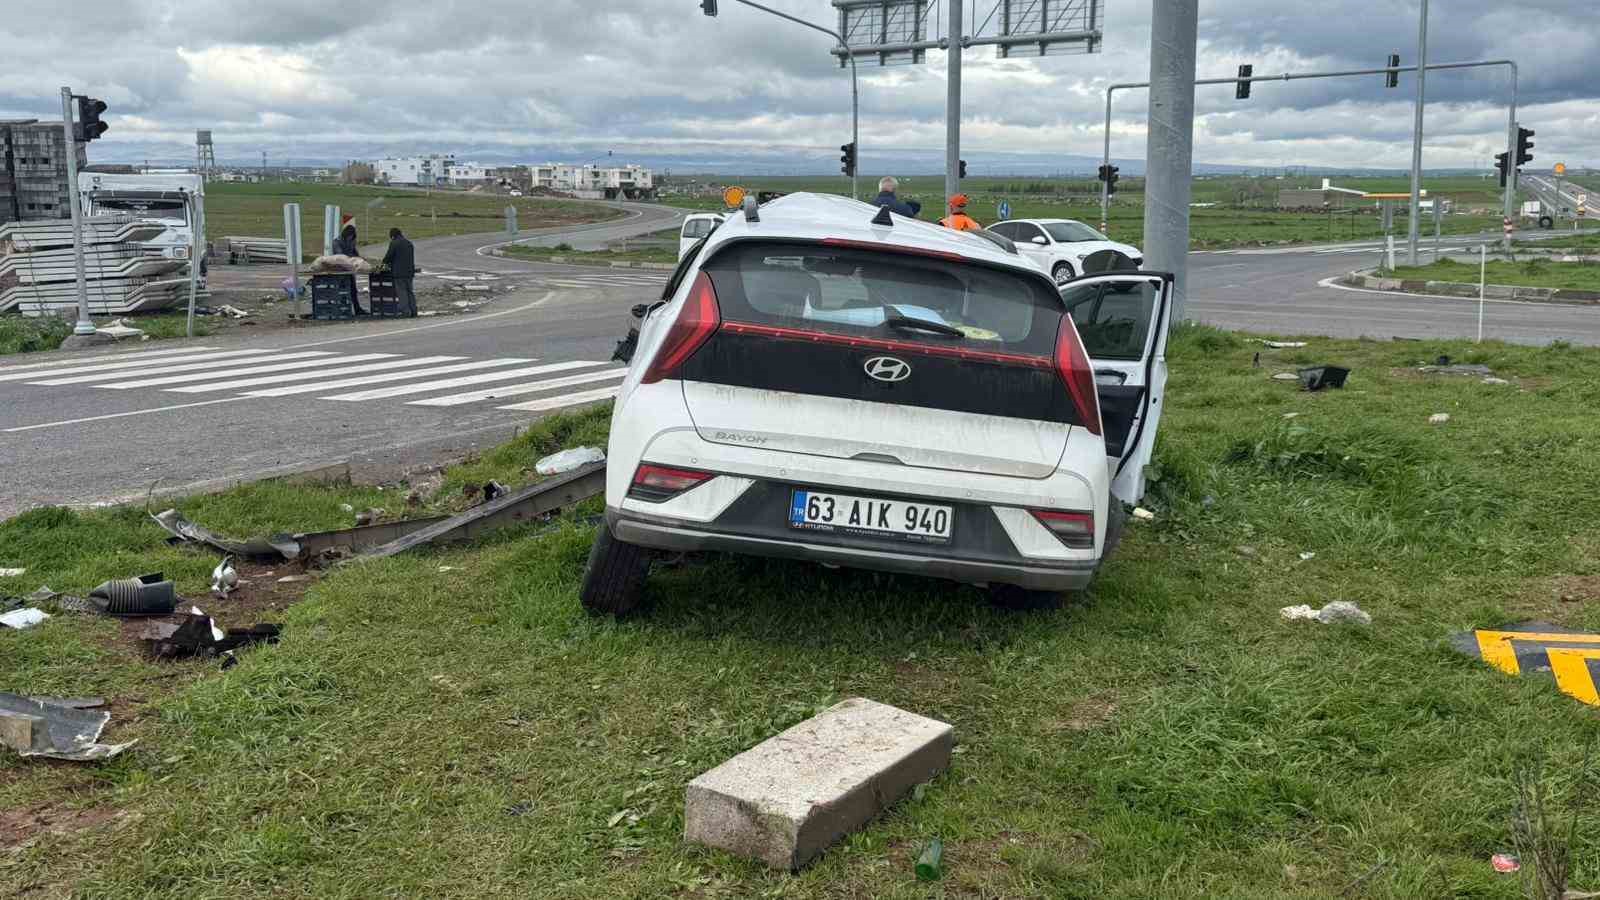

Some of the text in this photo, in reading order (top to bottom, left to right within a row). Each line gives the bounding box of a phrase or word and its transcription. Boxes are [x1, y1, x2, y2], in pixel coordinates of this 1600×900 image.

[793, 507, 804, 516] TR
[807, 495, 947, 534] 63 AIK 940
